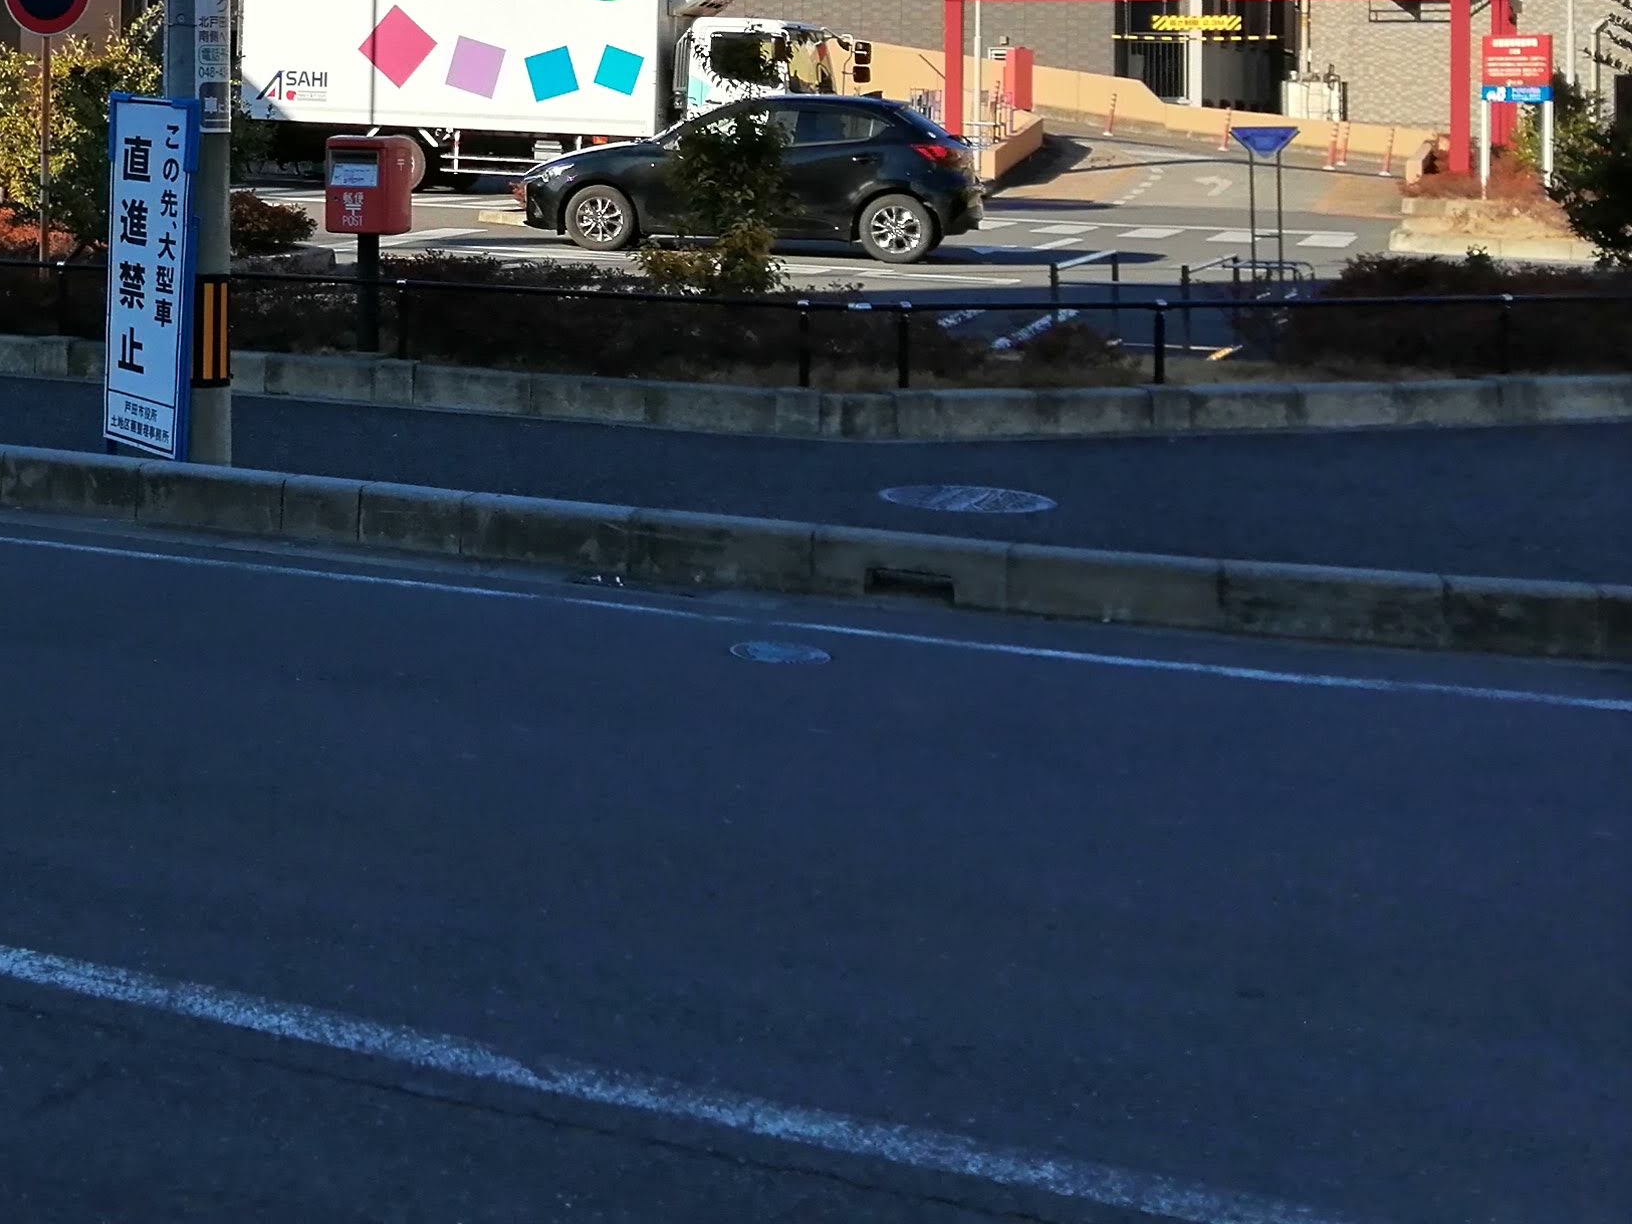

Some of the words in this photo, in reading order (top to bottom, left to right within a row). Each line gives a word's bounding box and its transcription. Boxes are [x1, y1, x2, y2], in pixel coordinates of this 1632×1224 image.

[117, 135, 153, 375] 直進禁止
[153, 124, 180, 328] この先、大型車
[342, 215, 364, 227] POST
[124, 400, 159, 423] 戸田市役所
